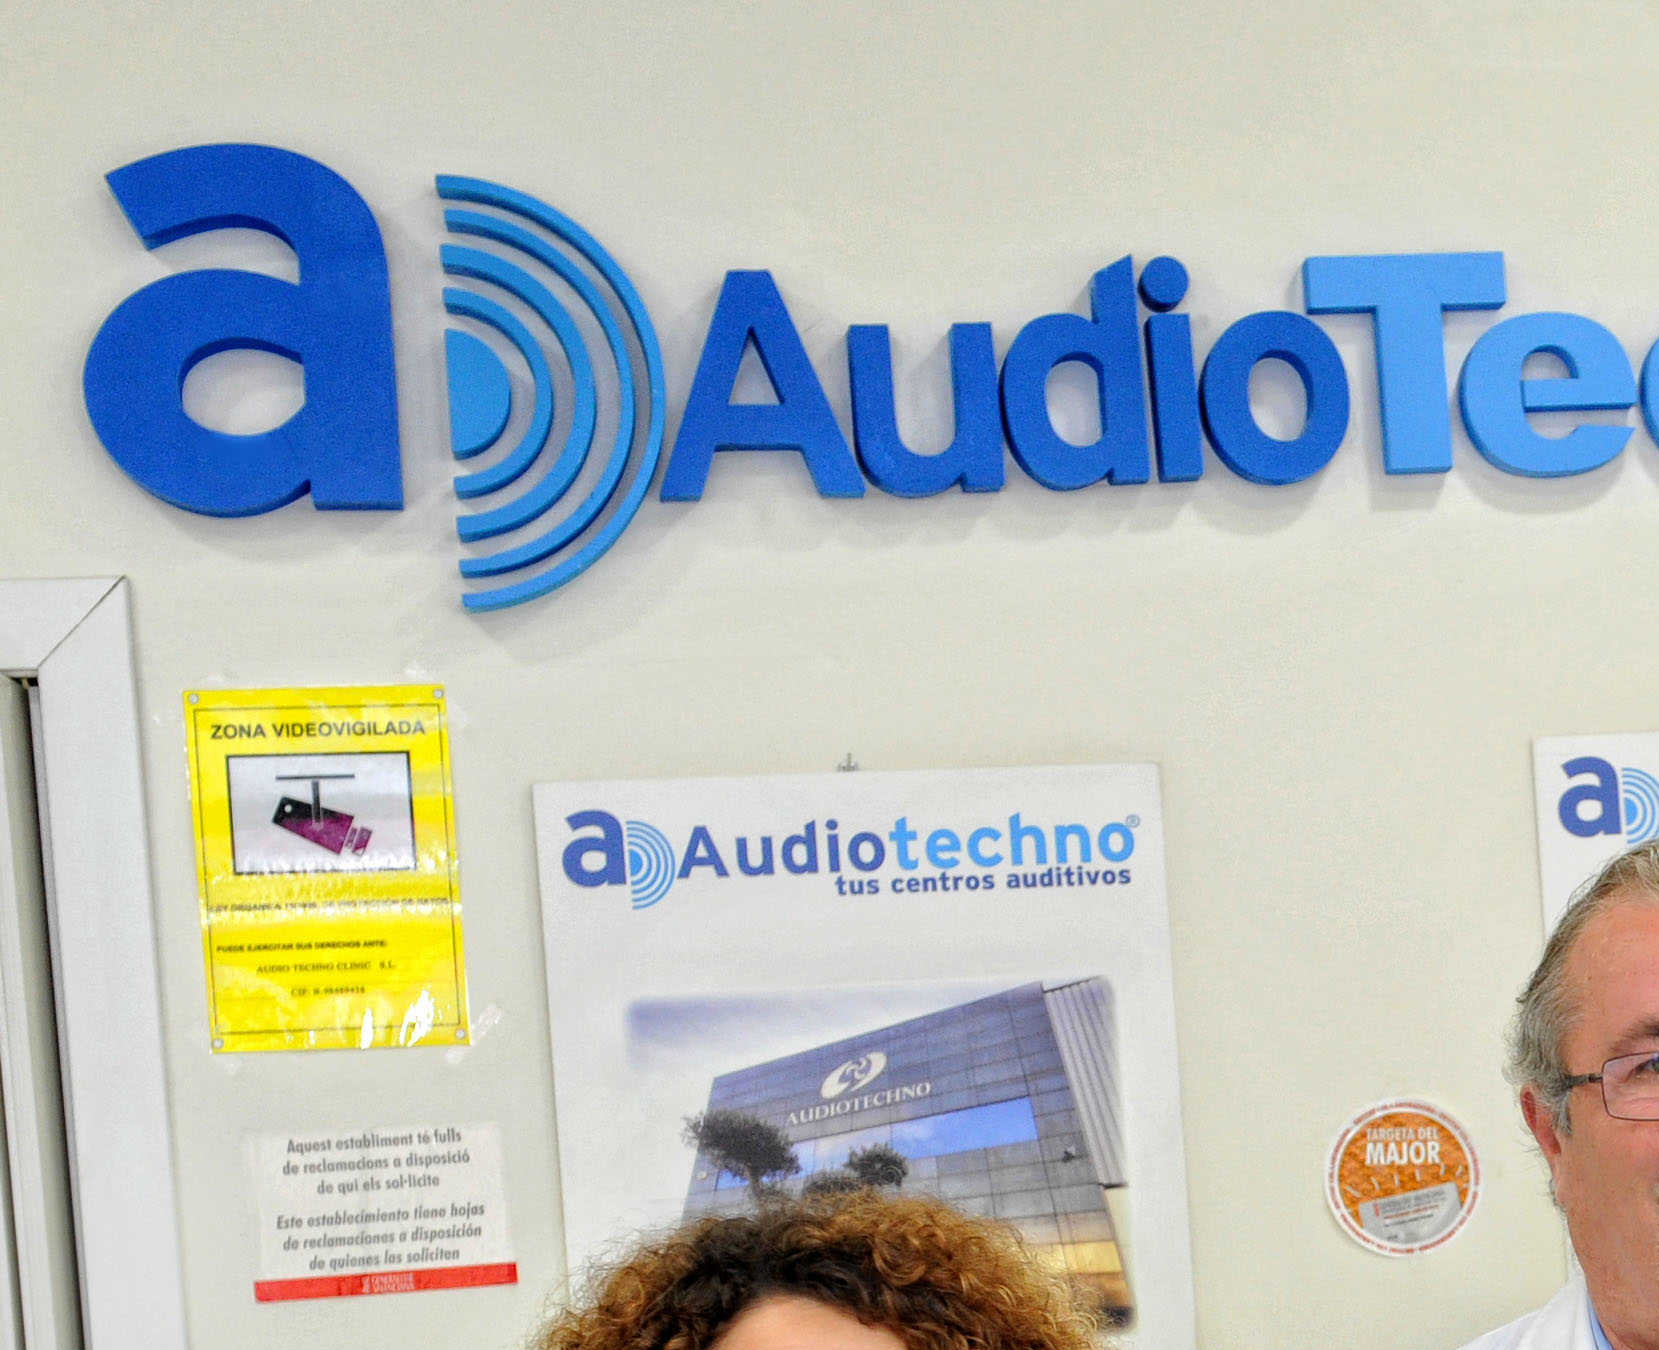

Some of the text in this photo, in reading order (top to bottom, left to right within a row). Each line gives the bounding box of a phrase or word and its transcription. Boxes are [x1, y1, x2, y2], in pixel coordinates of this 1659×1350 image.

[83, 142, 404, 518] a
[210, 719, 427, 740] ZONA VIDEOVIGILADA
[676, 810, 1136, 880] Audiotechno
[835, 864, 1132, 896] tus centros auditivos
[786, 1081, 932, 1126] AUDIOTECHNO
[286, 1138, 331, 1155] Aquest
[335, 1133, 413, 1150] establiment
[433, 1127, 462, 1144] fulls
[1365, 1126, 1440, 1141] TARGETA DEL
[282, 1147, 471, 1176] de reclamacions a disposició
[1365, 1140, 1442, 1166] MAJOR
[317, 1180, 334, 1195] de
[337, 1178, 359, 1197] qui
[362, 1176, 381, 1191] els
[276, 1201, 485, 1230] Este establecimiento tiene hojas
[282, 1224, 482, 1251] de reclamaciones a disposición
[309, 1247, 460, 1271] de quienes las soliciten
